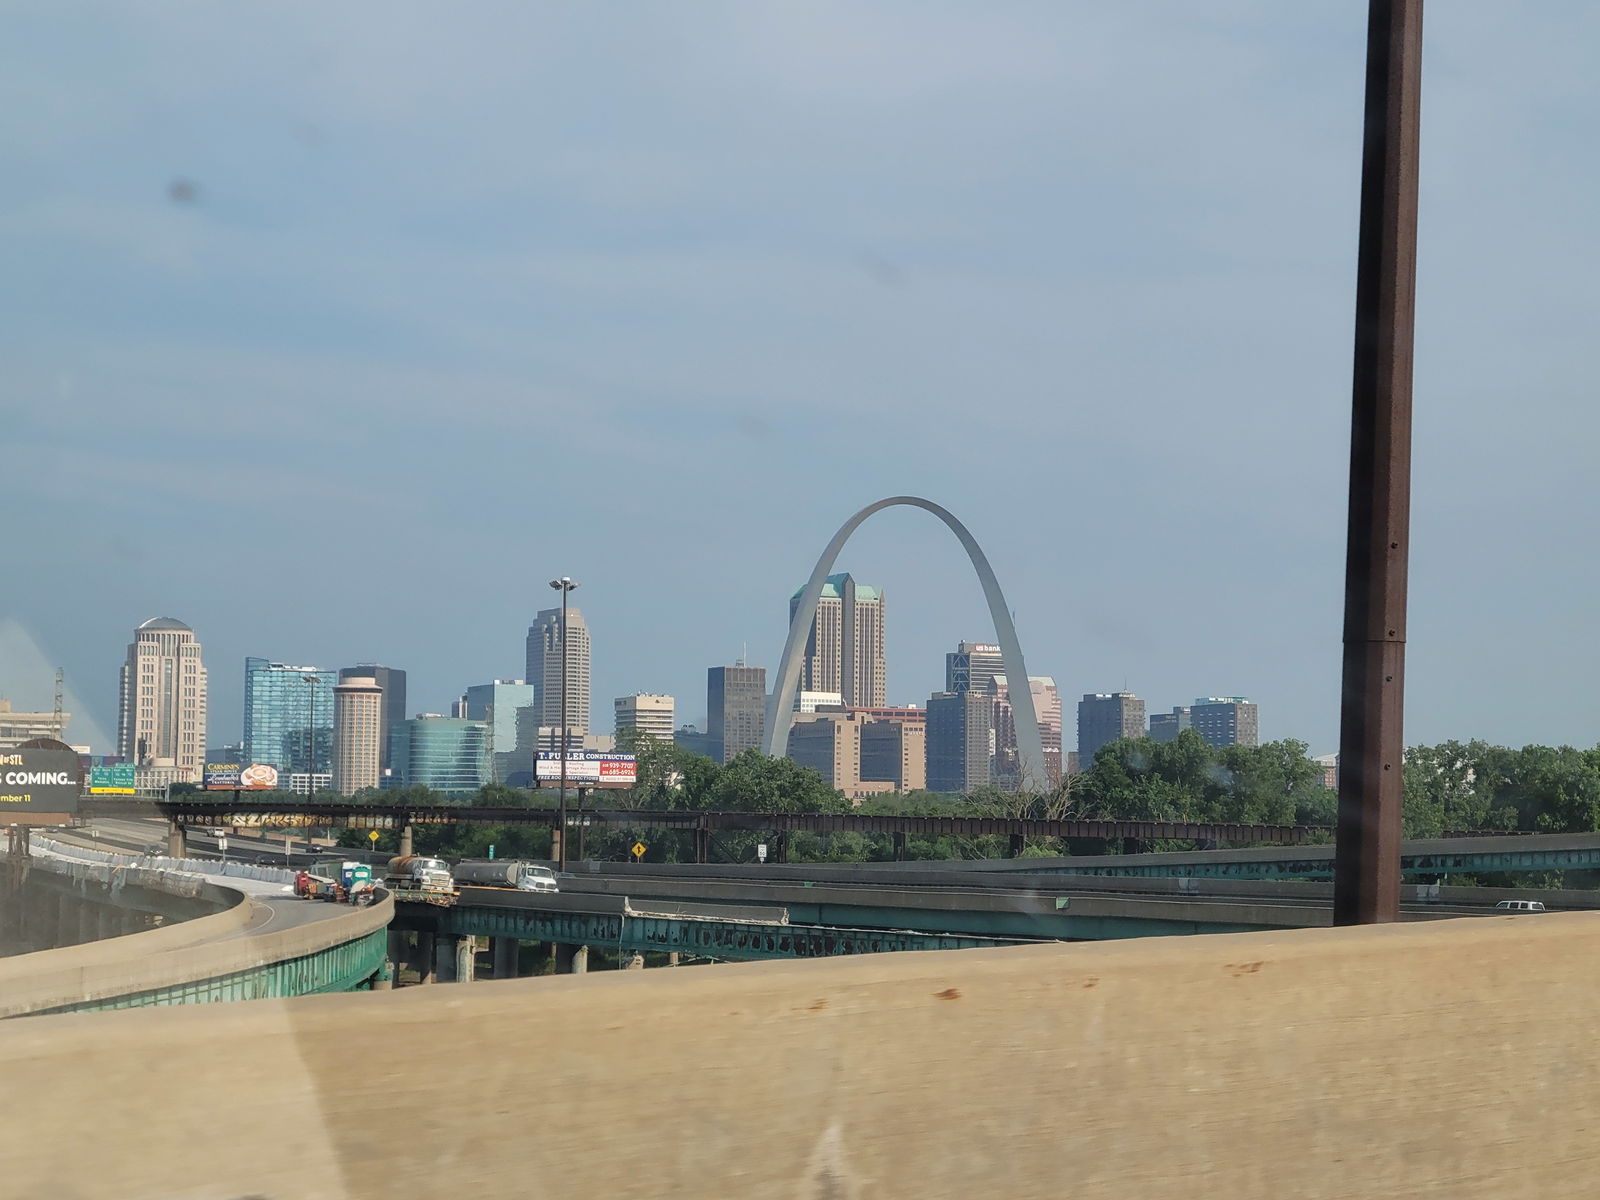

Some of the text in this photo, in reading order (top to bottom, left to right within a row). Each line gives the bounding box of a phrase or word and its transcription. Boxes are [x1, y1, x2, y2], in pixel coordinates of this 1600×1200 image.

[9, 754, 23, 766] STL
[548, 752, 585, 761] FULER
[585, 753, 636, 761] CONSTRUCTION
